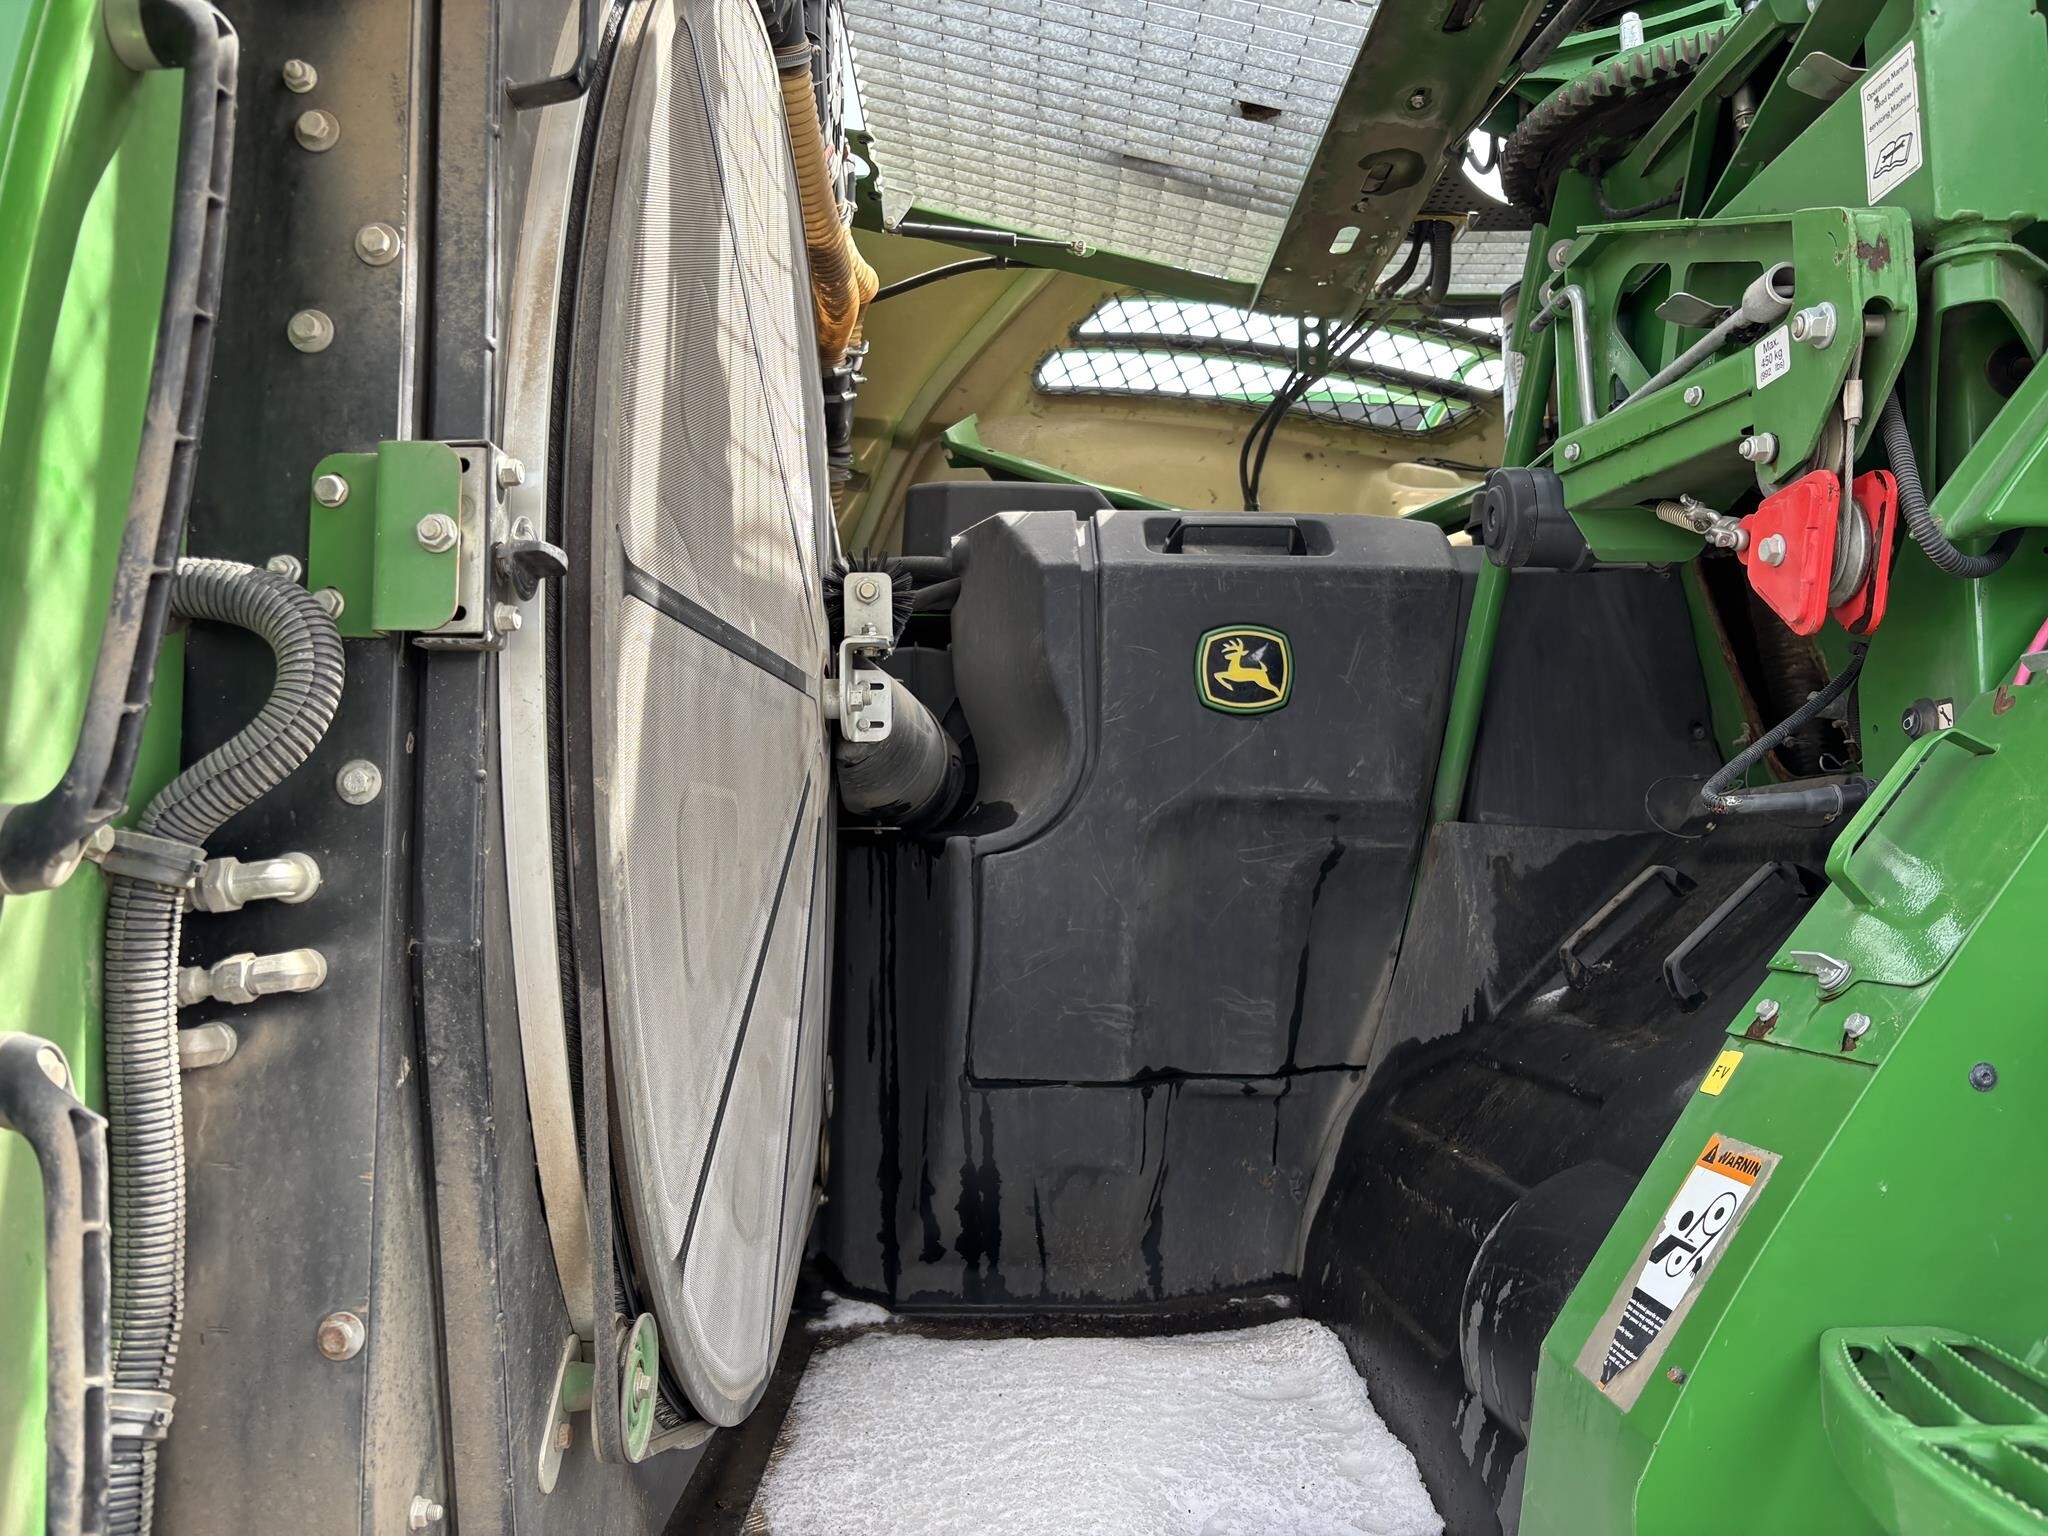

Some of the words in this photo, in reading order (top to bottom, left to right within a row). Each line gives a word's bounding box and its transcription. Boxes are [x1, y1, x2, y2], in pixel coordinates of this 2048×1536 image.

[1866, 77, 1890, 101] Operators
[1891, 58, 1909, 80] Manual
[1874, 95, 1887, 111] Read
[1888, 82, 1904, 100] before
[1868, 110, 1890, 133] servicing
[1891, 92, 1912, 114] Machine
[1761, 353, 1773, 368] 450
[1774, 349, 1783, 361] kg
[1763, 338, 1779, 354] Max.
[1712, 1064, 1731, 1079] FV
[1718, 1151, 1762, 1177] WARNIN
